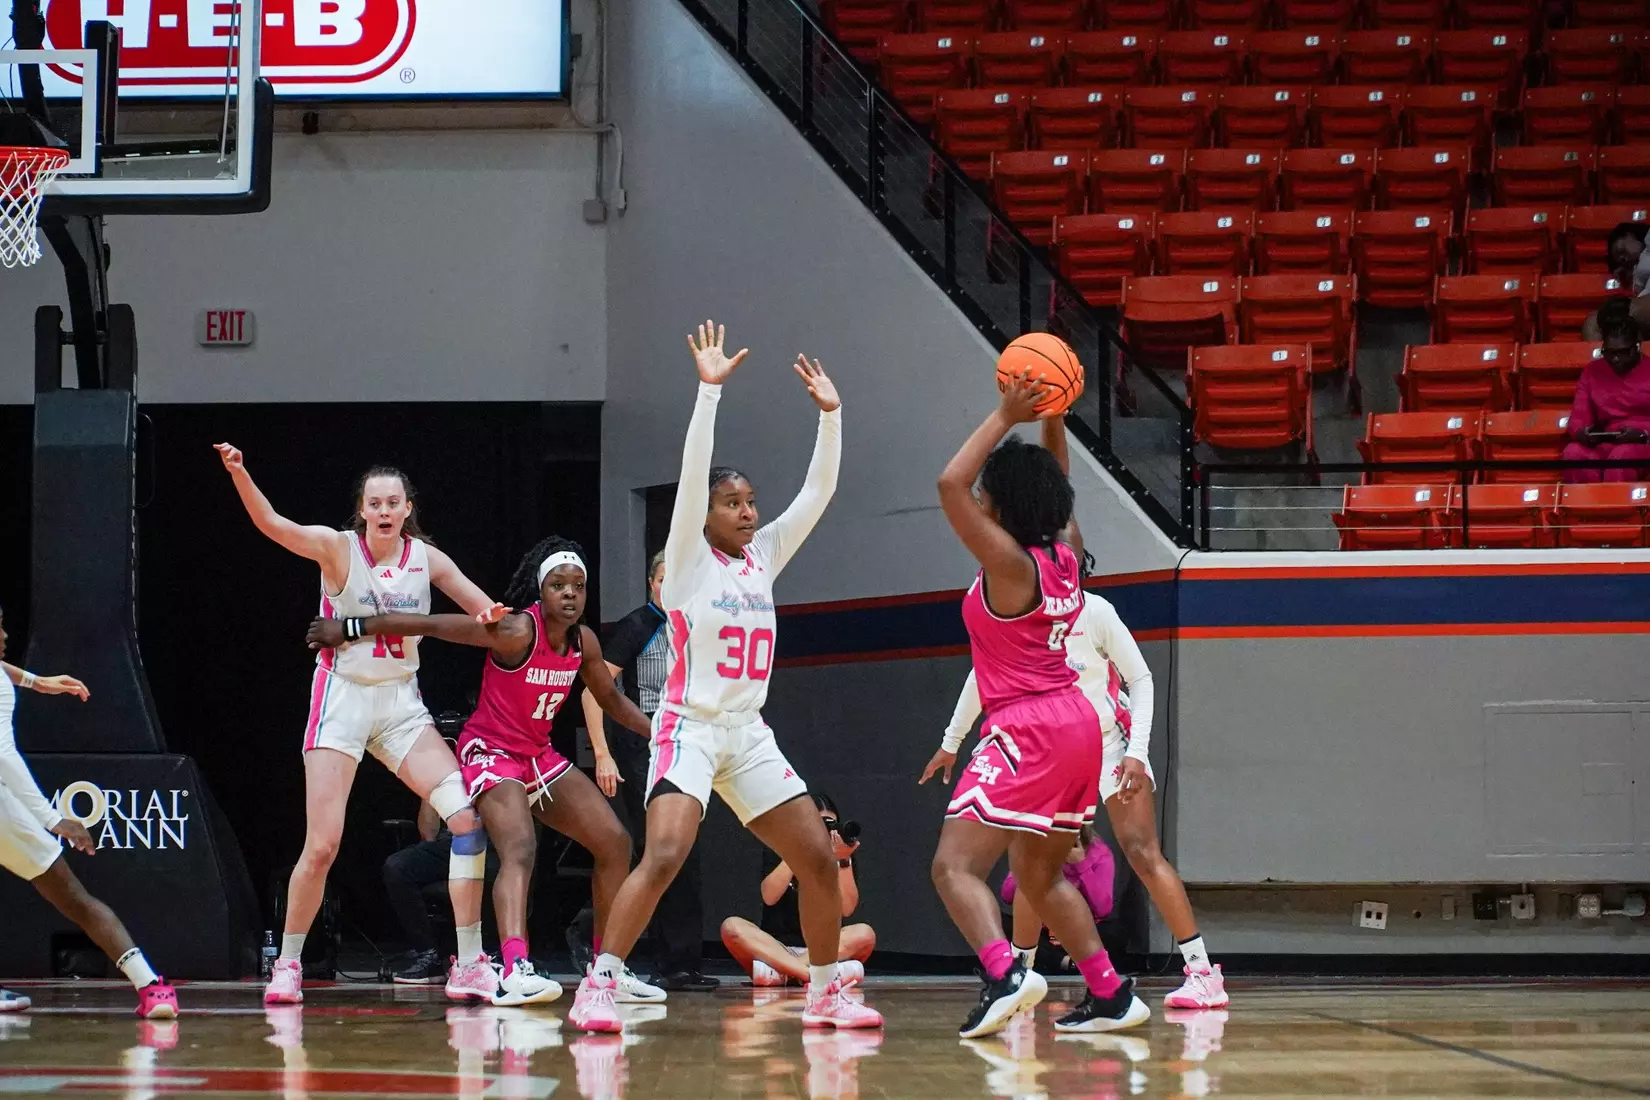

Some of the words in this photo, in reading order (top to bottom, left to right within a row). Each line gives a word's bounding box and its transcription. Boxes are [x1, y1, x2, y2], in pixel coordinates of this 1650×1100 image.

[206, 311, 246, 342] EXIT
[716, 625, 773, 681] 30
[525, 667, 549, 686] SAM
[531, 692, 565, 720] 12
